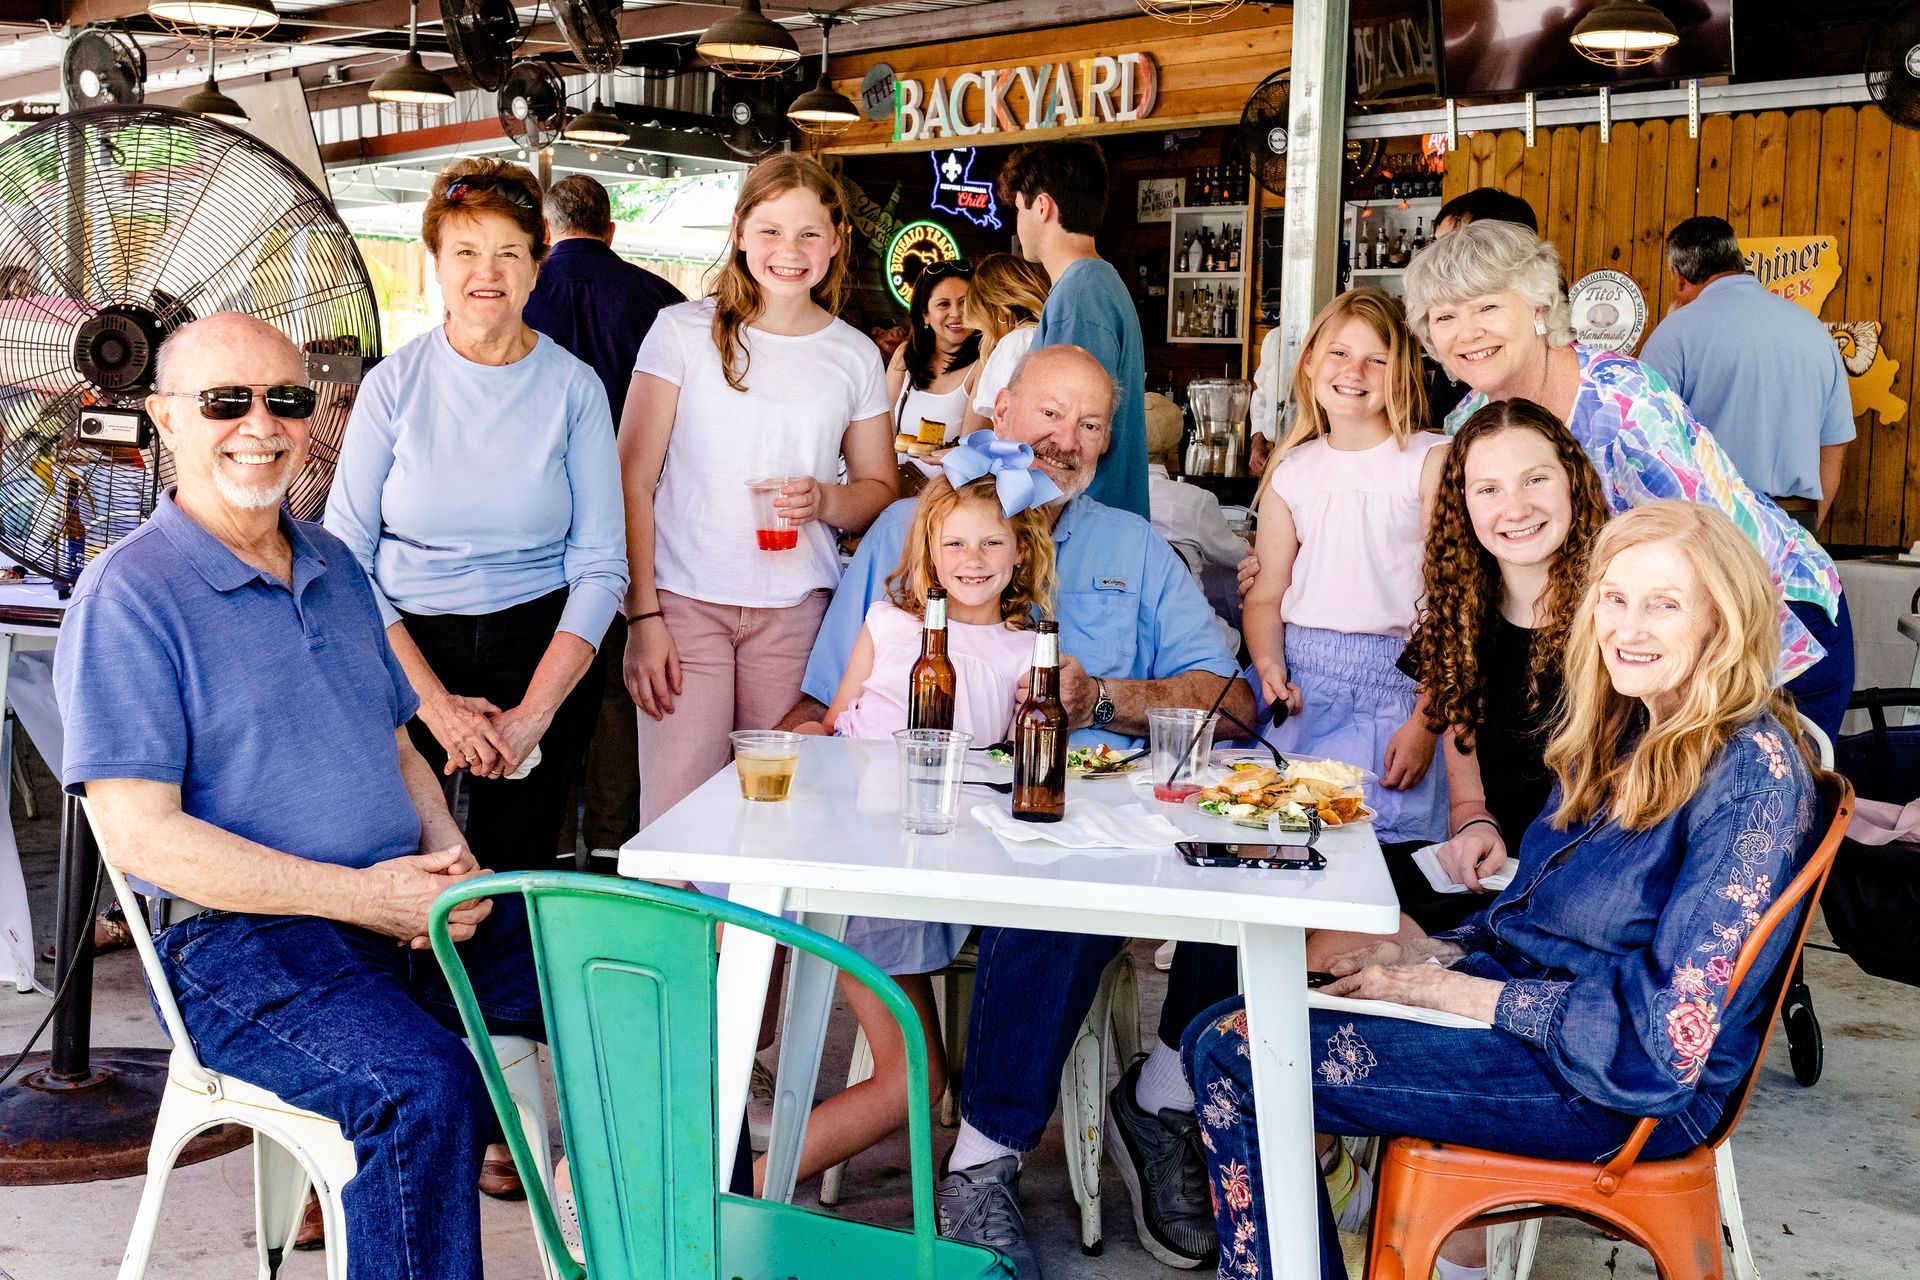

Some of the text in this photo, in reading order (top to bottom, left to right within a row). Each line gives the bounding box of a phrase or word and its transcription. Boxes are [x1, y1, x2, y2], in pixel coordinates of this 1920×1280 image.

[862, 52, 1158, 142] THE BACKYARD
[957, 192, 989, 209] Chill
[890, 226, 956, 273] BUFFALO TRACE
[1744, 240, 1829, 288] Shiner
[1580, 271, 1618, 288] ORIGINAL
[1620, 276, 1641, 300] CRAFT
[1635, 301, 1644, 333] VODKA
[1585, 287, 1623, 301] Tito's
[1578, 328, 1626, 340] Handmade
